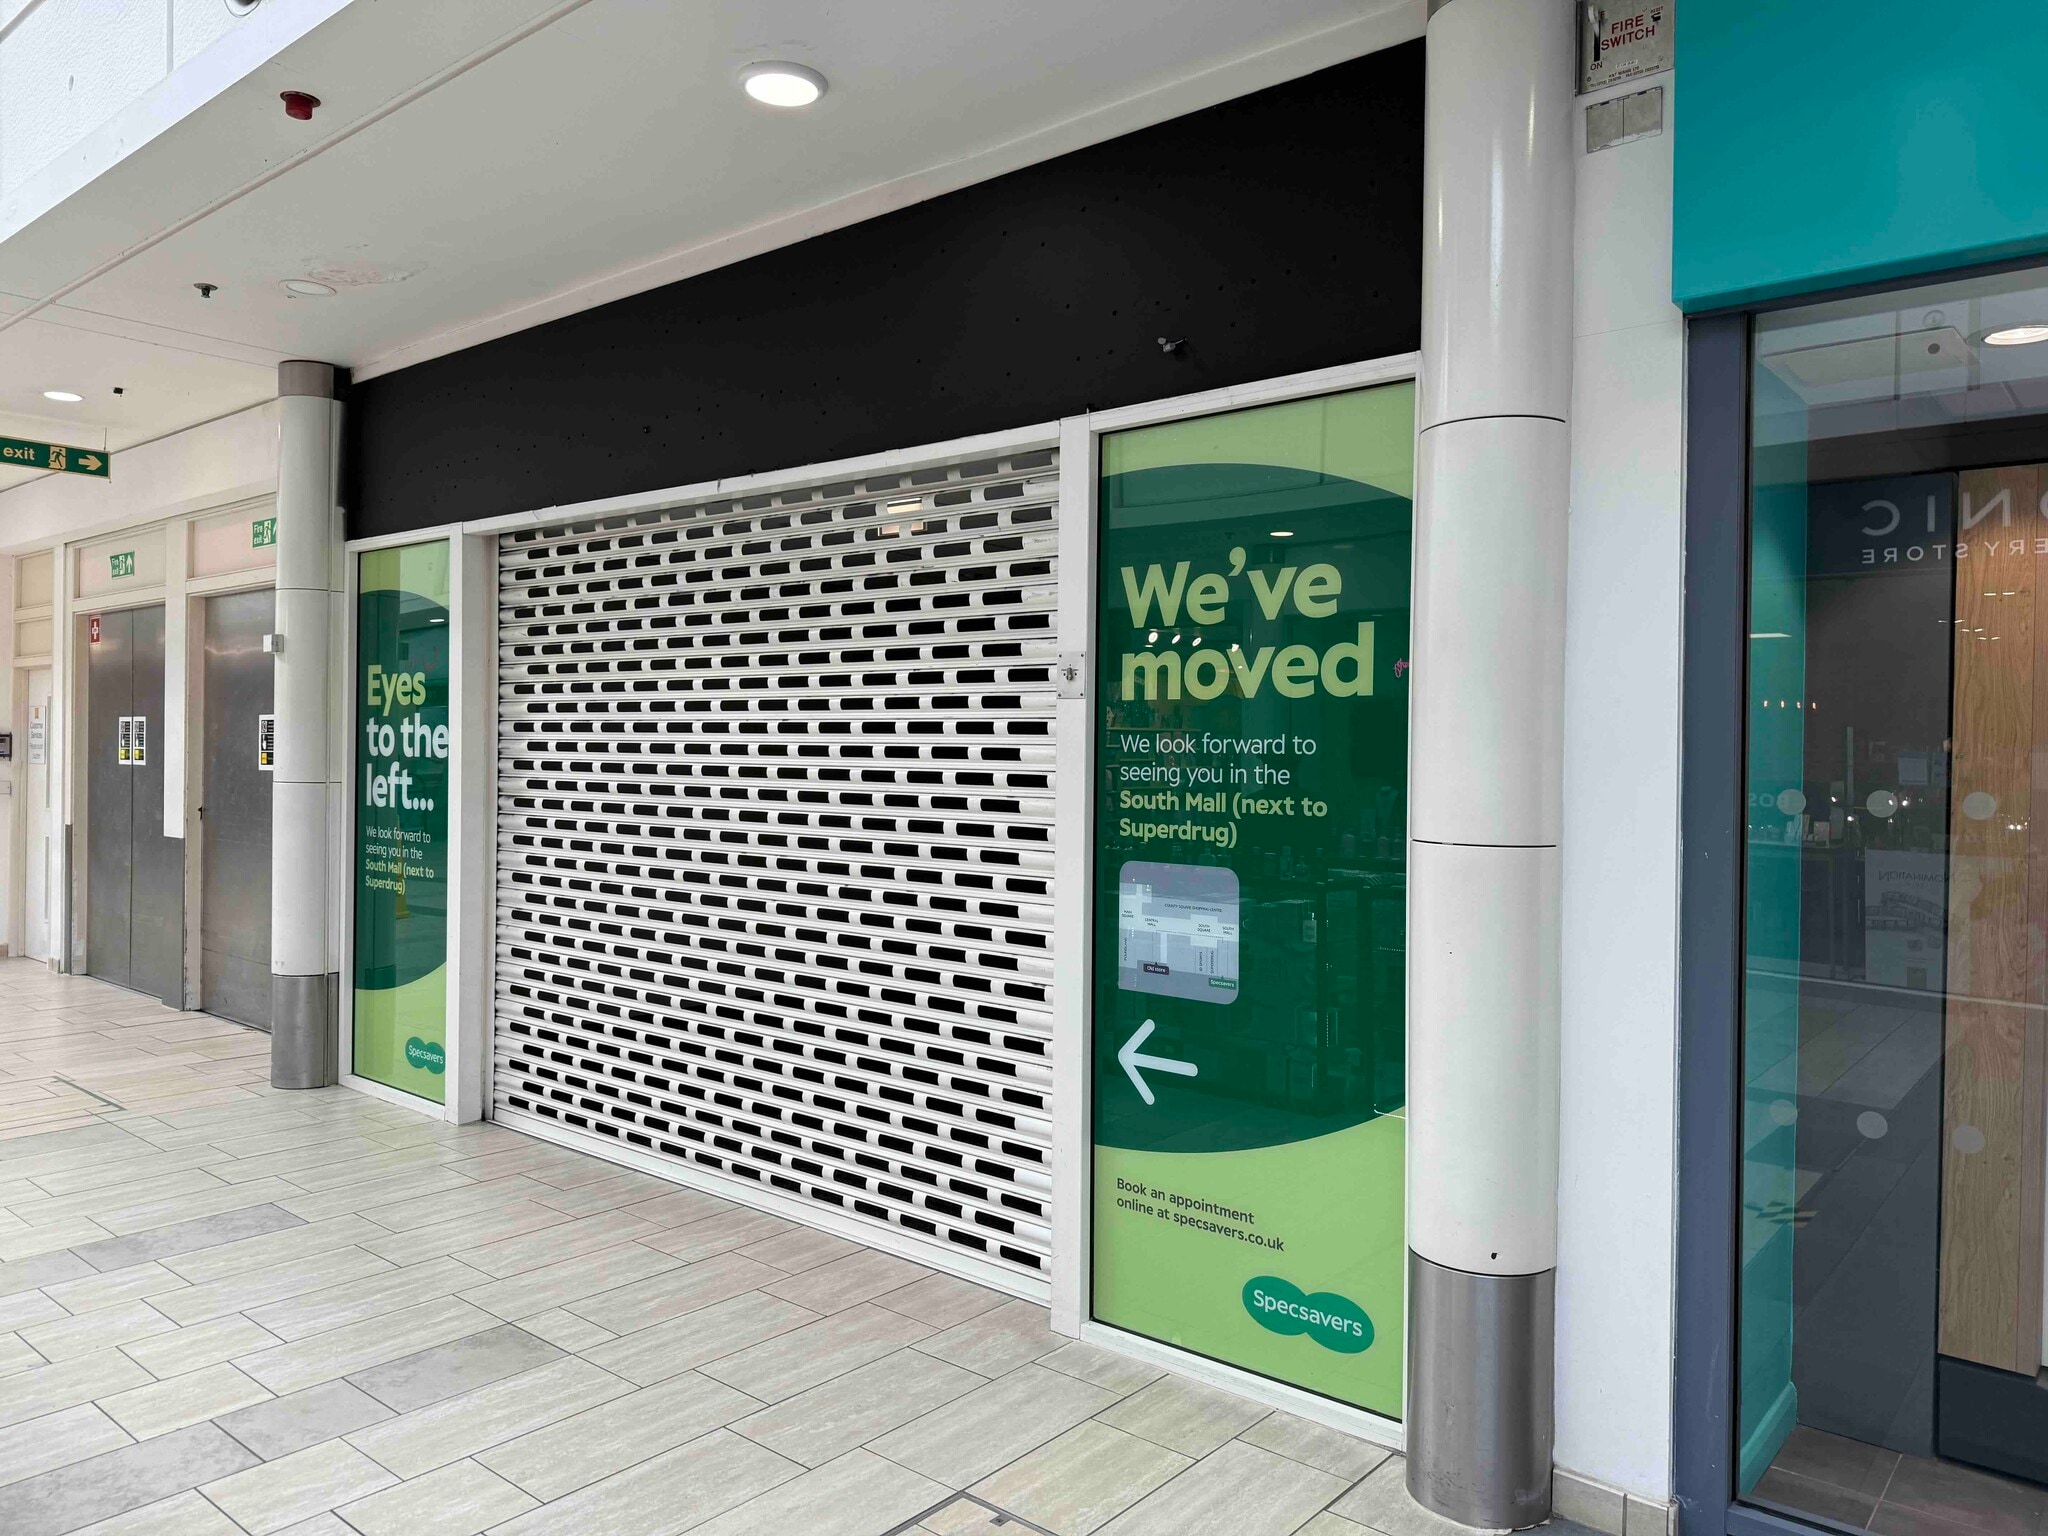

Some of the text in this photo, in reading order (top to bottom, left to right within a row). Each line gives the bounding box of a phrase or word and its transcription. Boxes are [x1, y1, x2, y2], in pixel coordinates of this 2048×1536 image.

[1612, 15, 1644, 34] FIRE
[1601, 25, 1655, 51] SWITCH
[1590, 61, 1603, 71] ON
[3, 447, 35, 460] exit
[1121, 621, 1375, 701] moved
[367, 664, 426, 716] Eyes
[366, 712, 449, 759] to the
[1120, 732, 1316, 755] We look forward to
[366, 761, 434, 812] left...
[1120, 762, 1291, 787] seeing you in the
[1119, 790, 1328, 819] South Mall (next to
[366, 825, 431, 843] We look forward to
[1119, 818, 1238, 848] Superdrug)
[365, 843, 423, 859] seeing you in the
[365, 859, 434, 878] South Mall (next to
[365, 875, 405, 895] Superdrug)
[409, 1045, 444, 1064] Specsavers
[1117, 1177, 1254, 1225] Book an appointment
[1116, 1197, 1284, 1252] online at specsavers.co.uk
[1253, 1289, 1363, 1337] Specsavers
